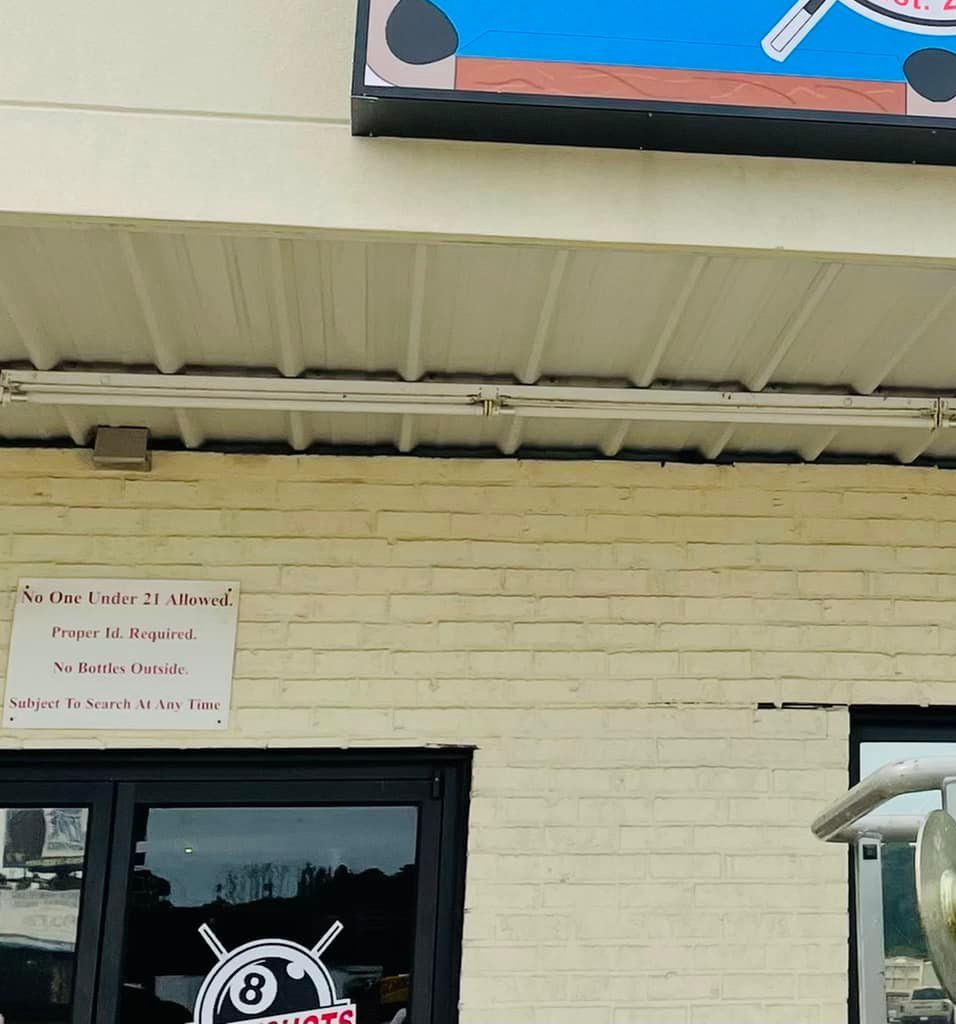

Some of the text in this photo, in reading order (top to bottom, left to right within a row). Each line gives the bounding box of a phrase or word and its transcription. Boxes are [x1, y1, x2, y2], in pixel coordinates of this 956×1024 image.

[21, 590, 233, 607] No One Under 21 Allowed.
[52, 626, 197, 643] Proper Id. Required.
[53, 661, 189, 675] No Bottles Outside.
[9, 697, 221, 713] Subject To Search At Any Time
[239, 972, 266, 1006] 8
